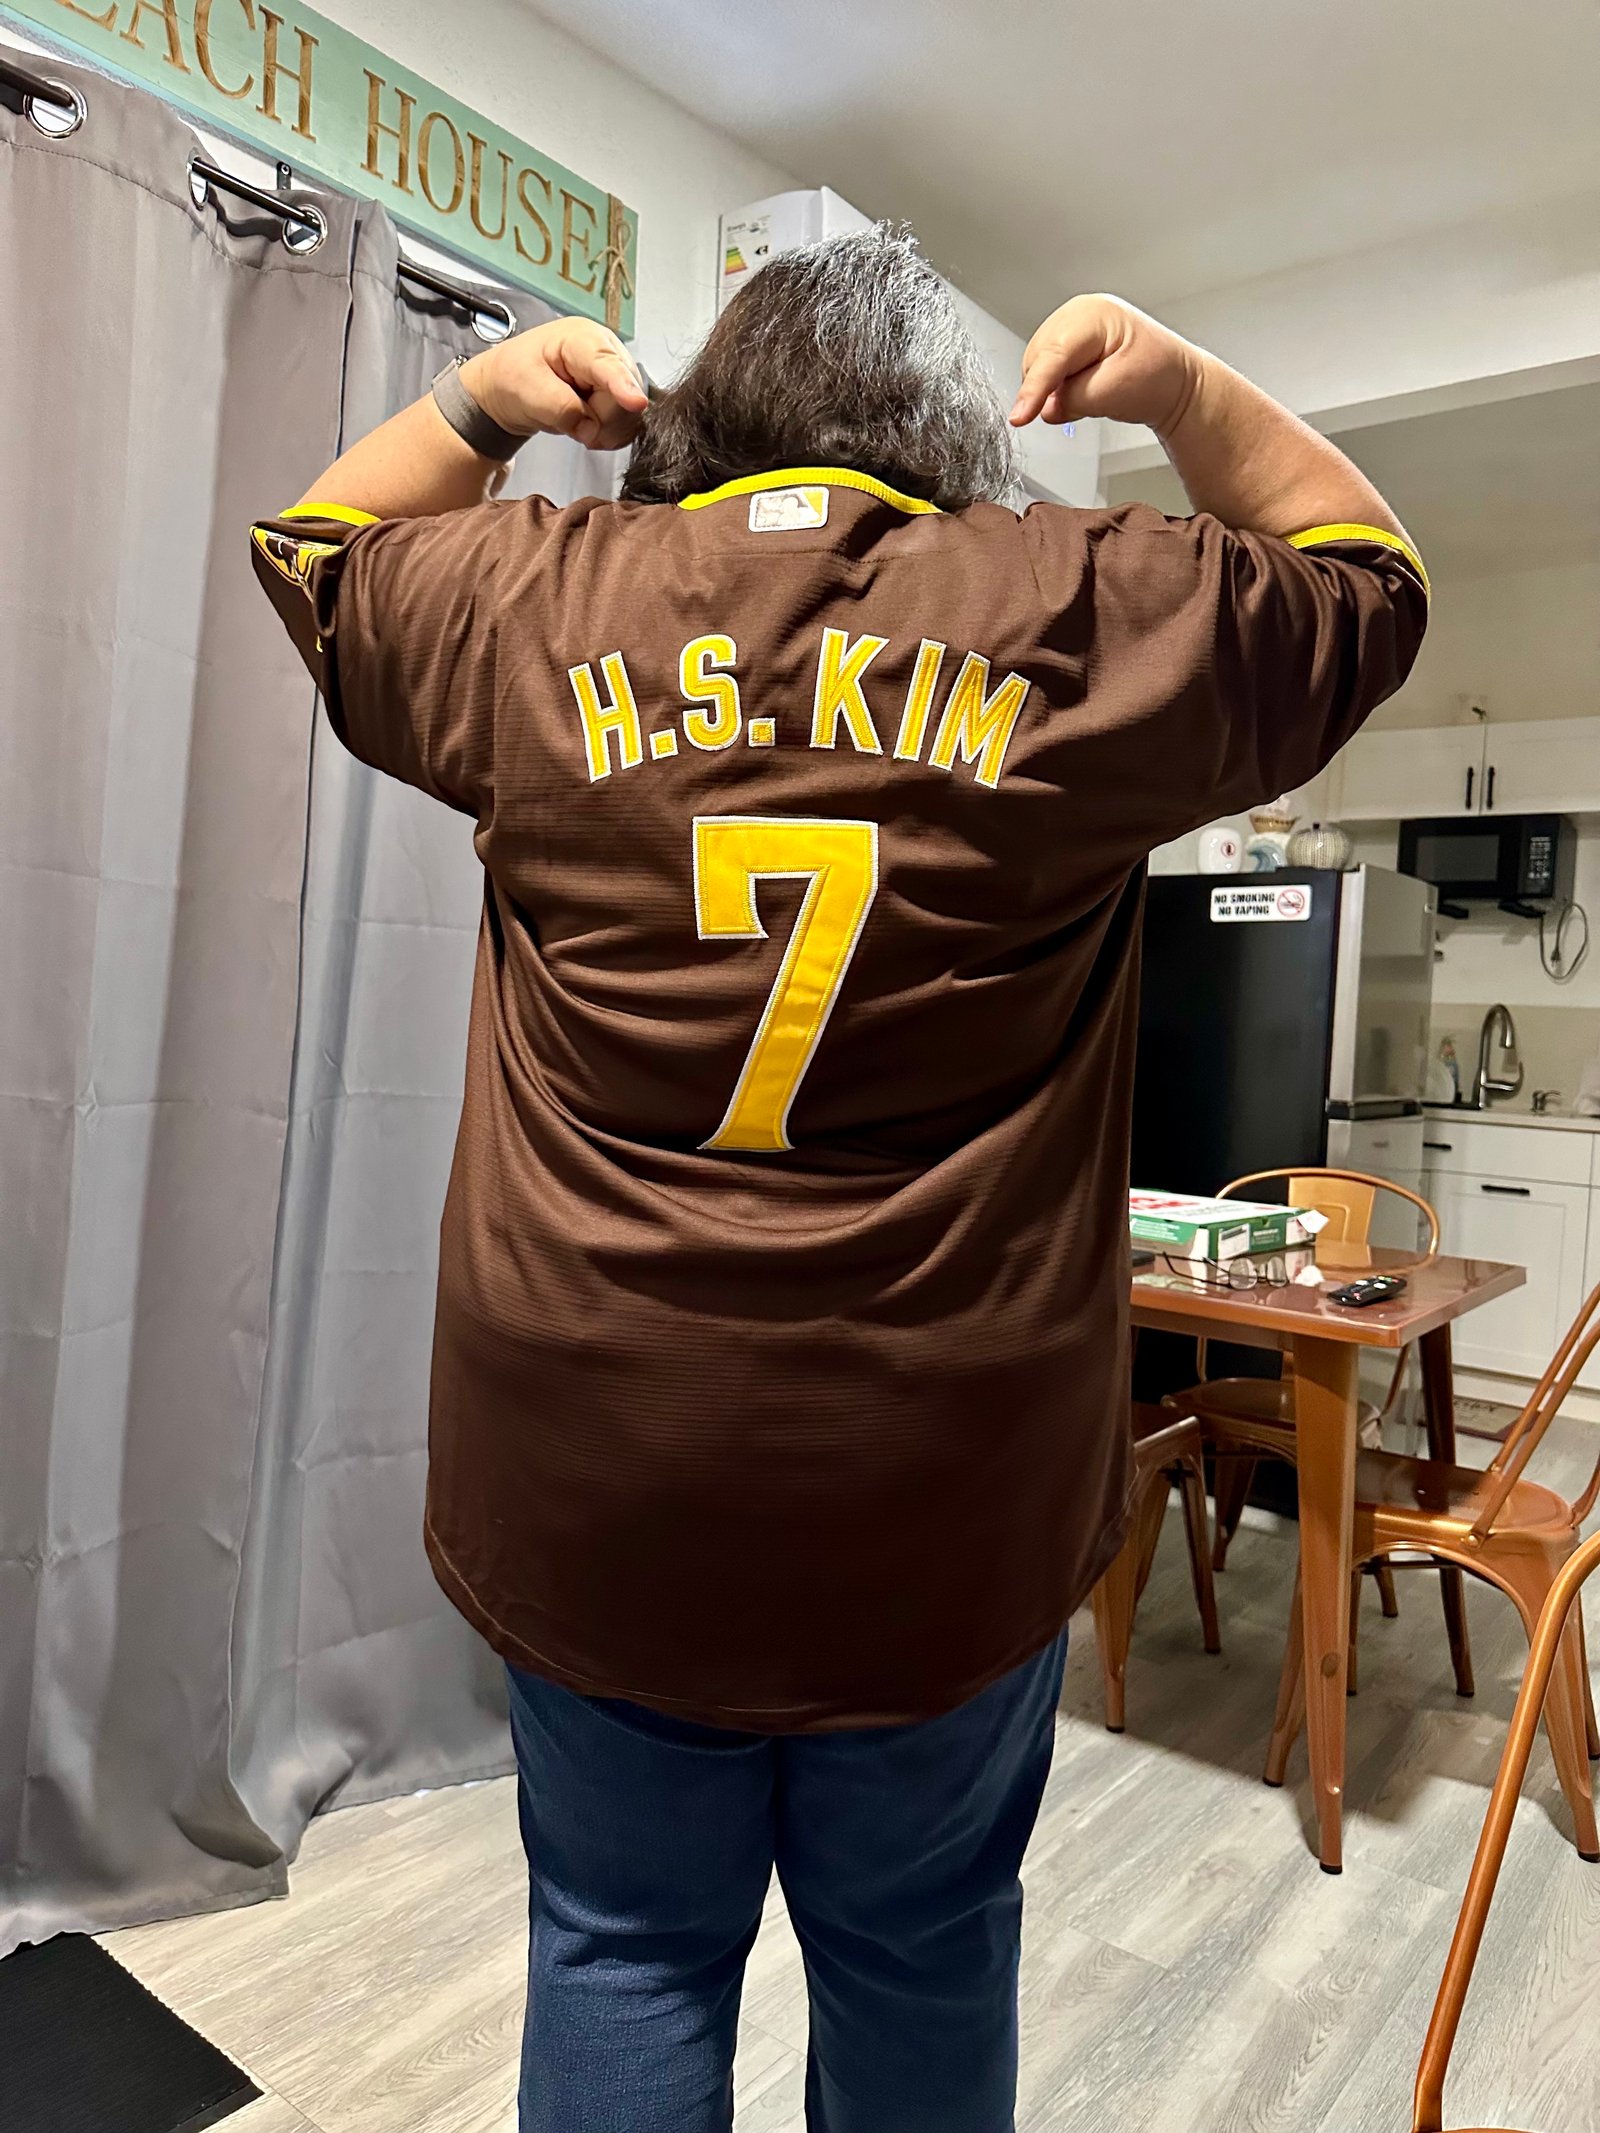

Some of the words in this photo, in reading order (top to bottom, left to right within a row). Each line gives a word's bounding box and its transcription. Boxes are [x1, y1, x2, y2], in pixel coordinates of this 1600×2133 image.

[360, 67, 598, 293] HOUSE
[568, 633, 775, 783] H.S.
[810, 627, 1031, 789] KIM
[1214, 894, 1227, 904] NO
[1231, 892, 1275, 904] SMOKING
[1218, 905, 1231, 915] NO
[693, 816, 879, 1151] 7
